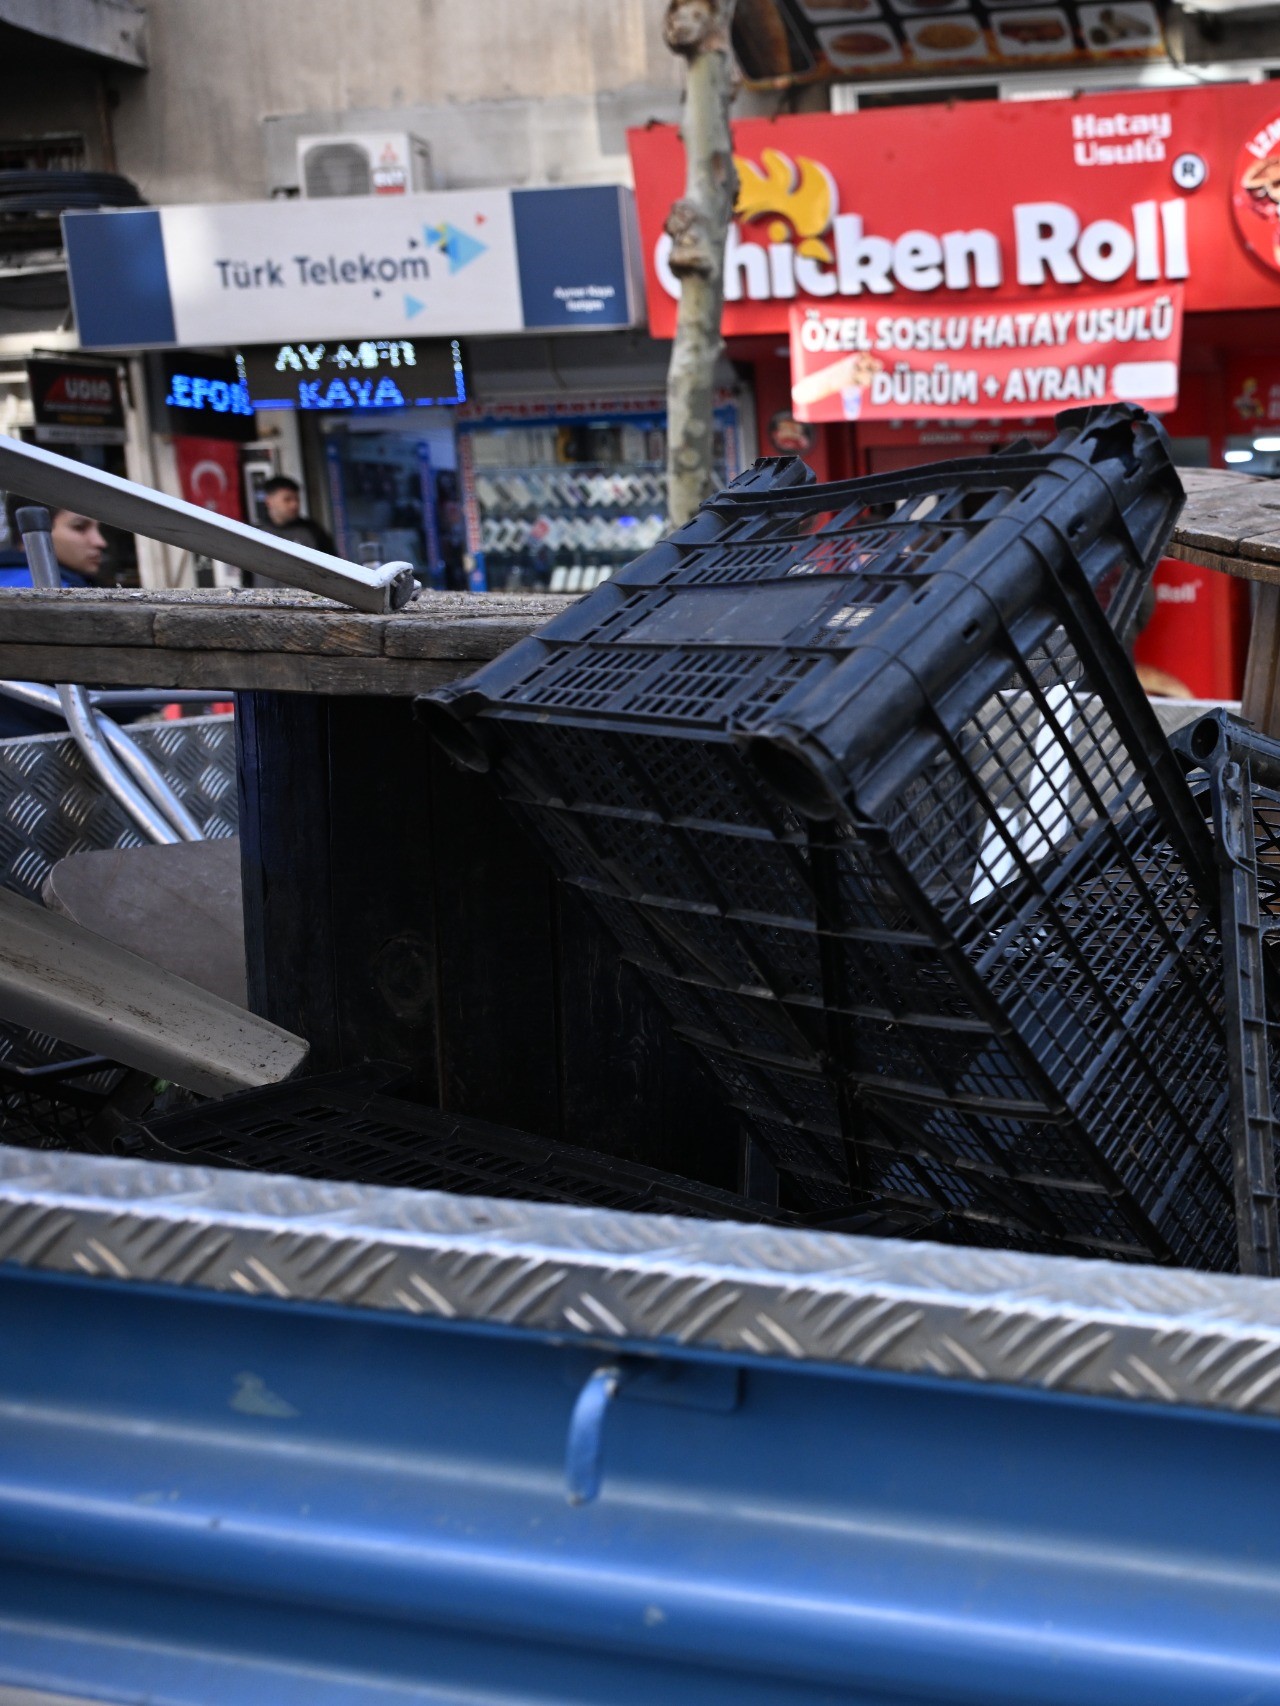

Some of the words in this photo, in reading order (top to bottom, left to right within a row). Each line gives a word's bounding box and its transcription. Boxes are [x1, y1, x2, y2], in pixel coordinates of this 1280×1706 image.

[1072, 112, 1171, 140] Hatay
[1074, 136, 1166, 166] Usulü
[1013, 197, 1189, 285] Roll
[216, 260, 284, 289] Türk
[295, 255, 429, 285] Telekom
[800, 310, 874, 351] ÖZEL
[876, 317, 969, 350] SOSLU
[971, 311, 1076, 348] HATAY
[1075, 297, 1174, 343] USULÜ
[298, 377, 404, 407] KAYA
[870, 361, 979, 405] DÜRÜM
[1003, 364, 1107, 402] AYRAN
